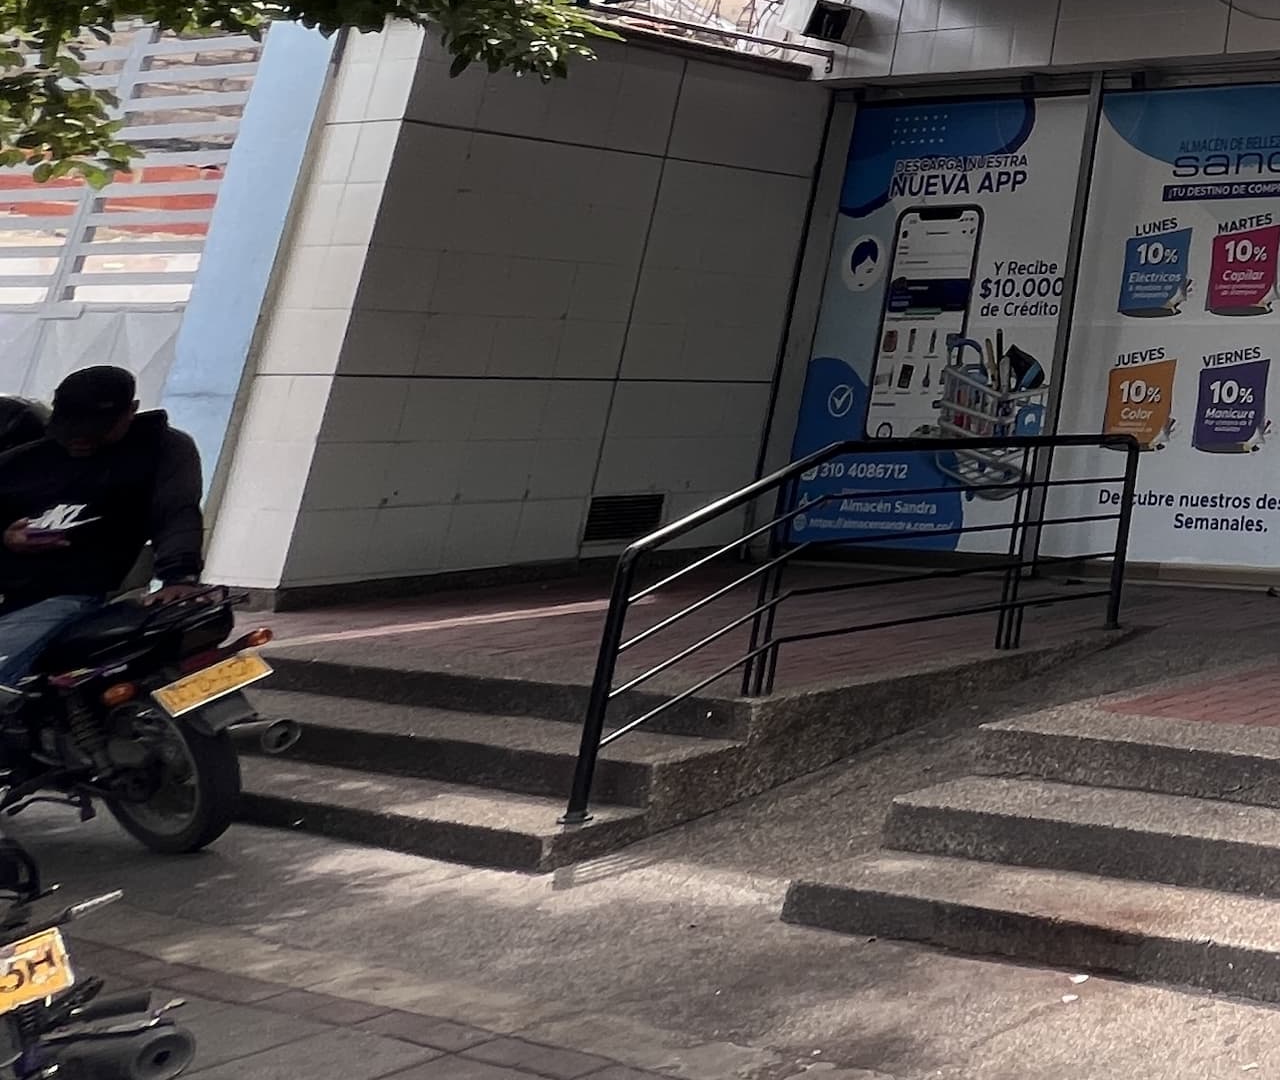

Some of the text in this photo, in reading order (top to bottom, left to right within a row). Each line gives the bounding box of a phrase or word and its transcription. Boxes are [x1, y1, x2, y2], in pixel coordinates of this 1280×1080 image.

[895, 154, 1028, 173] DESCARGA NUESTRA
[889, 170, 1028, 197] NUEVA APP
[1186, 185, 1231, 198] DESTINO
[1232, 184, 1247, 195] DE
[1135, 217, 1178, 237] LUNES
[1217, 213, 1273, 234] MARTES
[1136, 241, 1179, 265] 10%
[1224, 239, 1268, 263] 10%
[994, 260, 1058, 276] Y Recibe
[1222, 269, 1265, 283] Capilar
[979, 277, 1065, 299] $10.000
[980, 301, 1058, 317] de Crédito
[1115, 347, 1165, 367] JUEVES
[1202, 347, 1261, 367] VIERNES
[1119, 380, 1161, 404] 10%
[1209, 380, 1254, 404] 10%
[1120, 407, 1153, 420] Color
[1204, 407, 1256, 420] Manicure
[819, 462, 908, 480] 310 4086712
[894, 499, 937, 515] Sandra
[1179, 493, 1251, 509] nuestros
[1173, 513, 1268, 533] Semanales.
